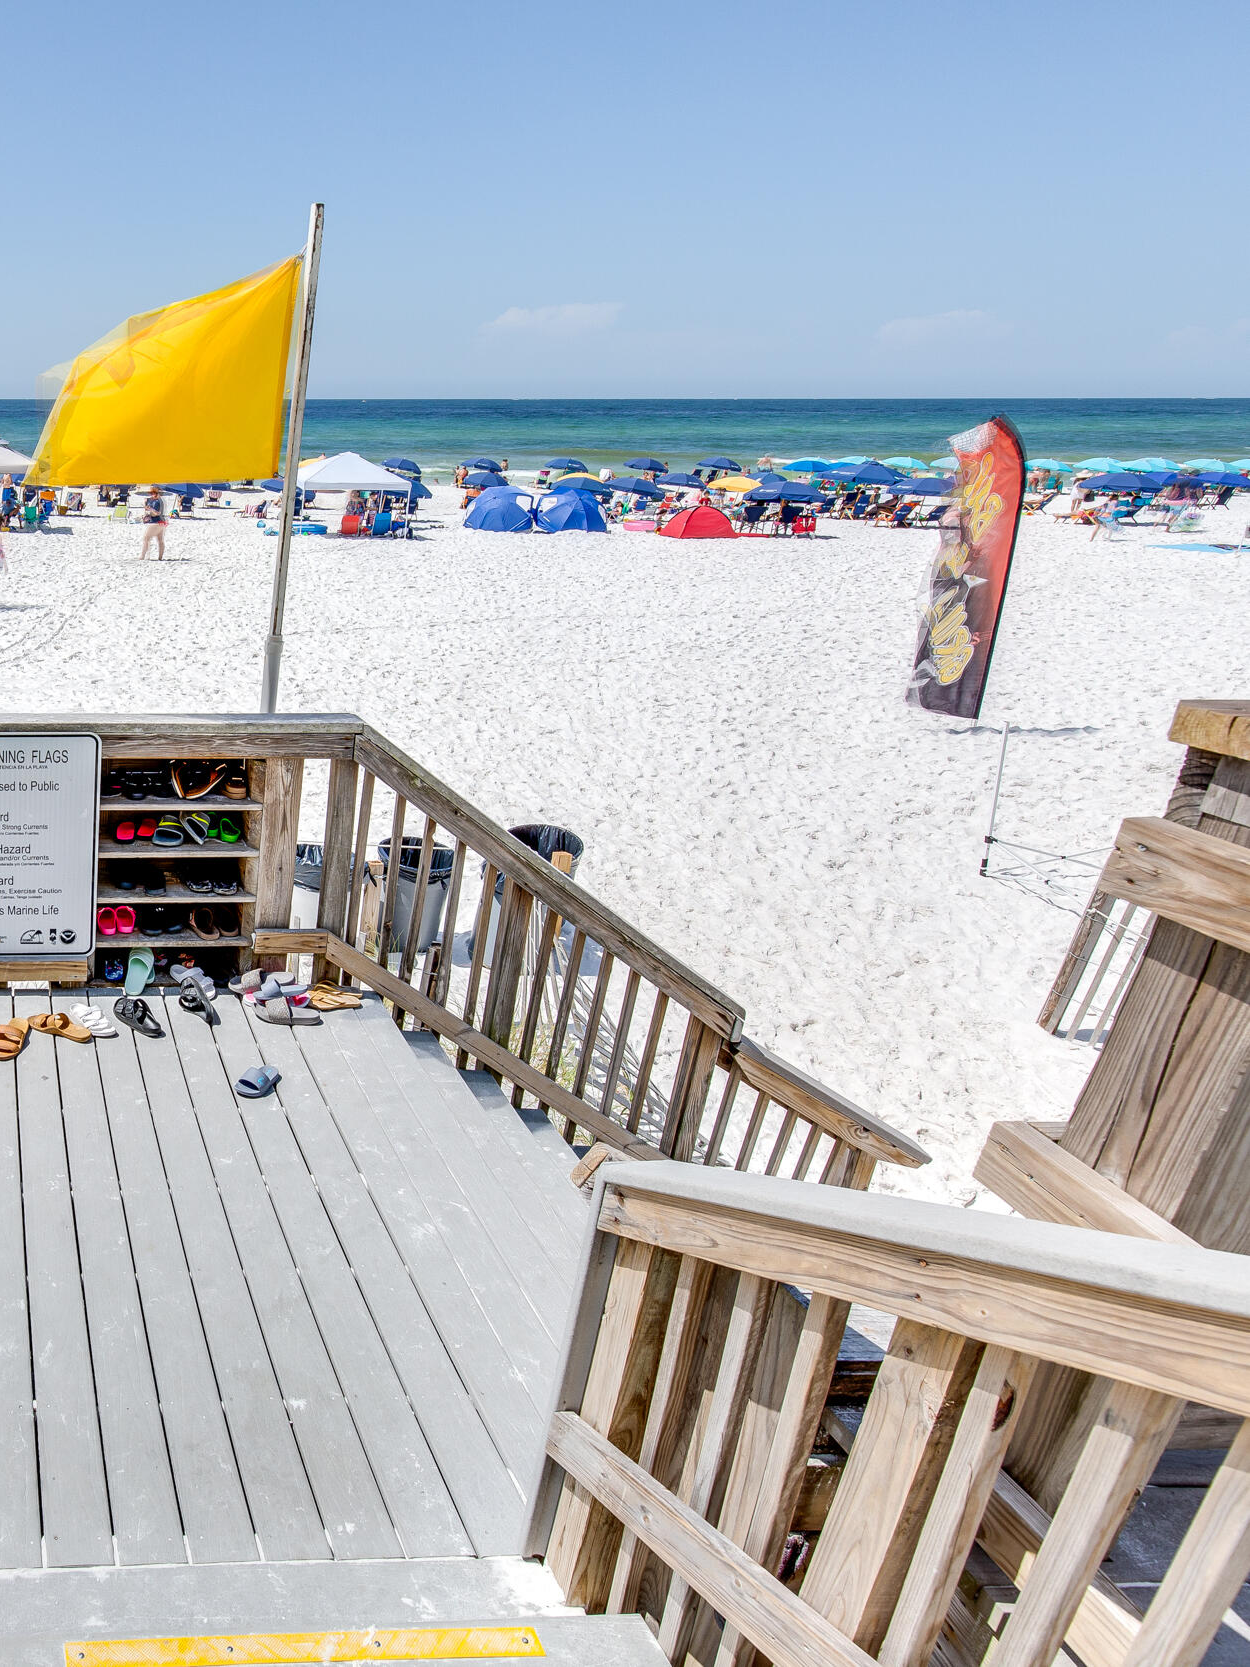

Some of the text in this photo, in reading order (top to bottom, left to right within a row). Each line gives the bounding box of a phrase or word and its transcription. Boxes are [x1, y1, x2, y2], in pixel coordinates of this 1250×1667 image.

[31, 750, 69, 764] FLAGS
[18, 782, 28, 791] to
[30, 780, 60, 791] Public
[8, 906, 39, 915] Marine
[42, 905, 59, 914] Life
